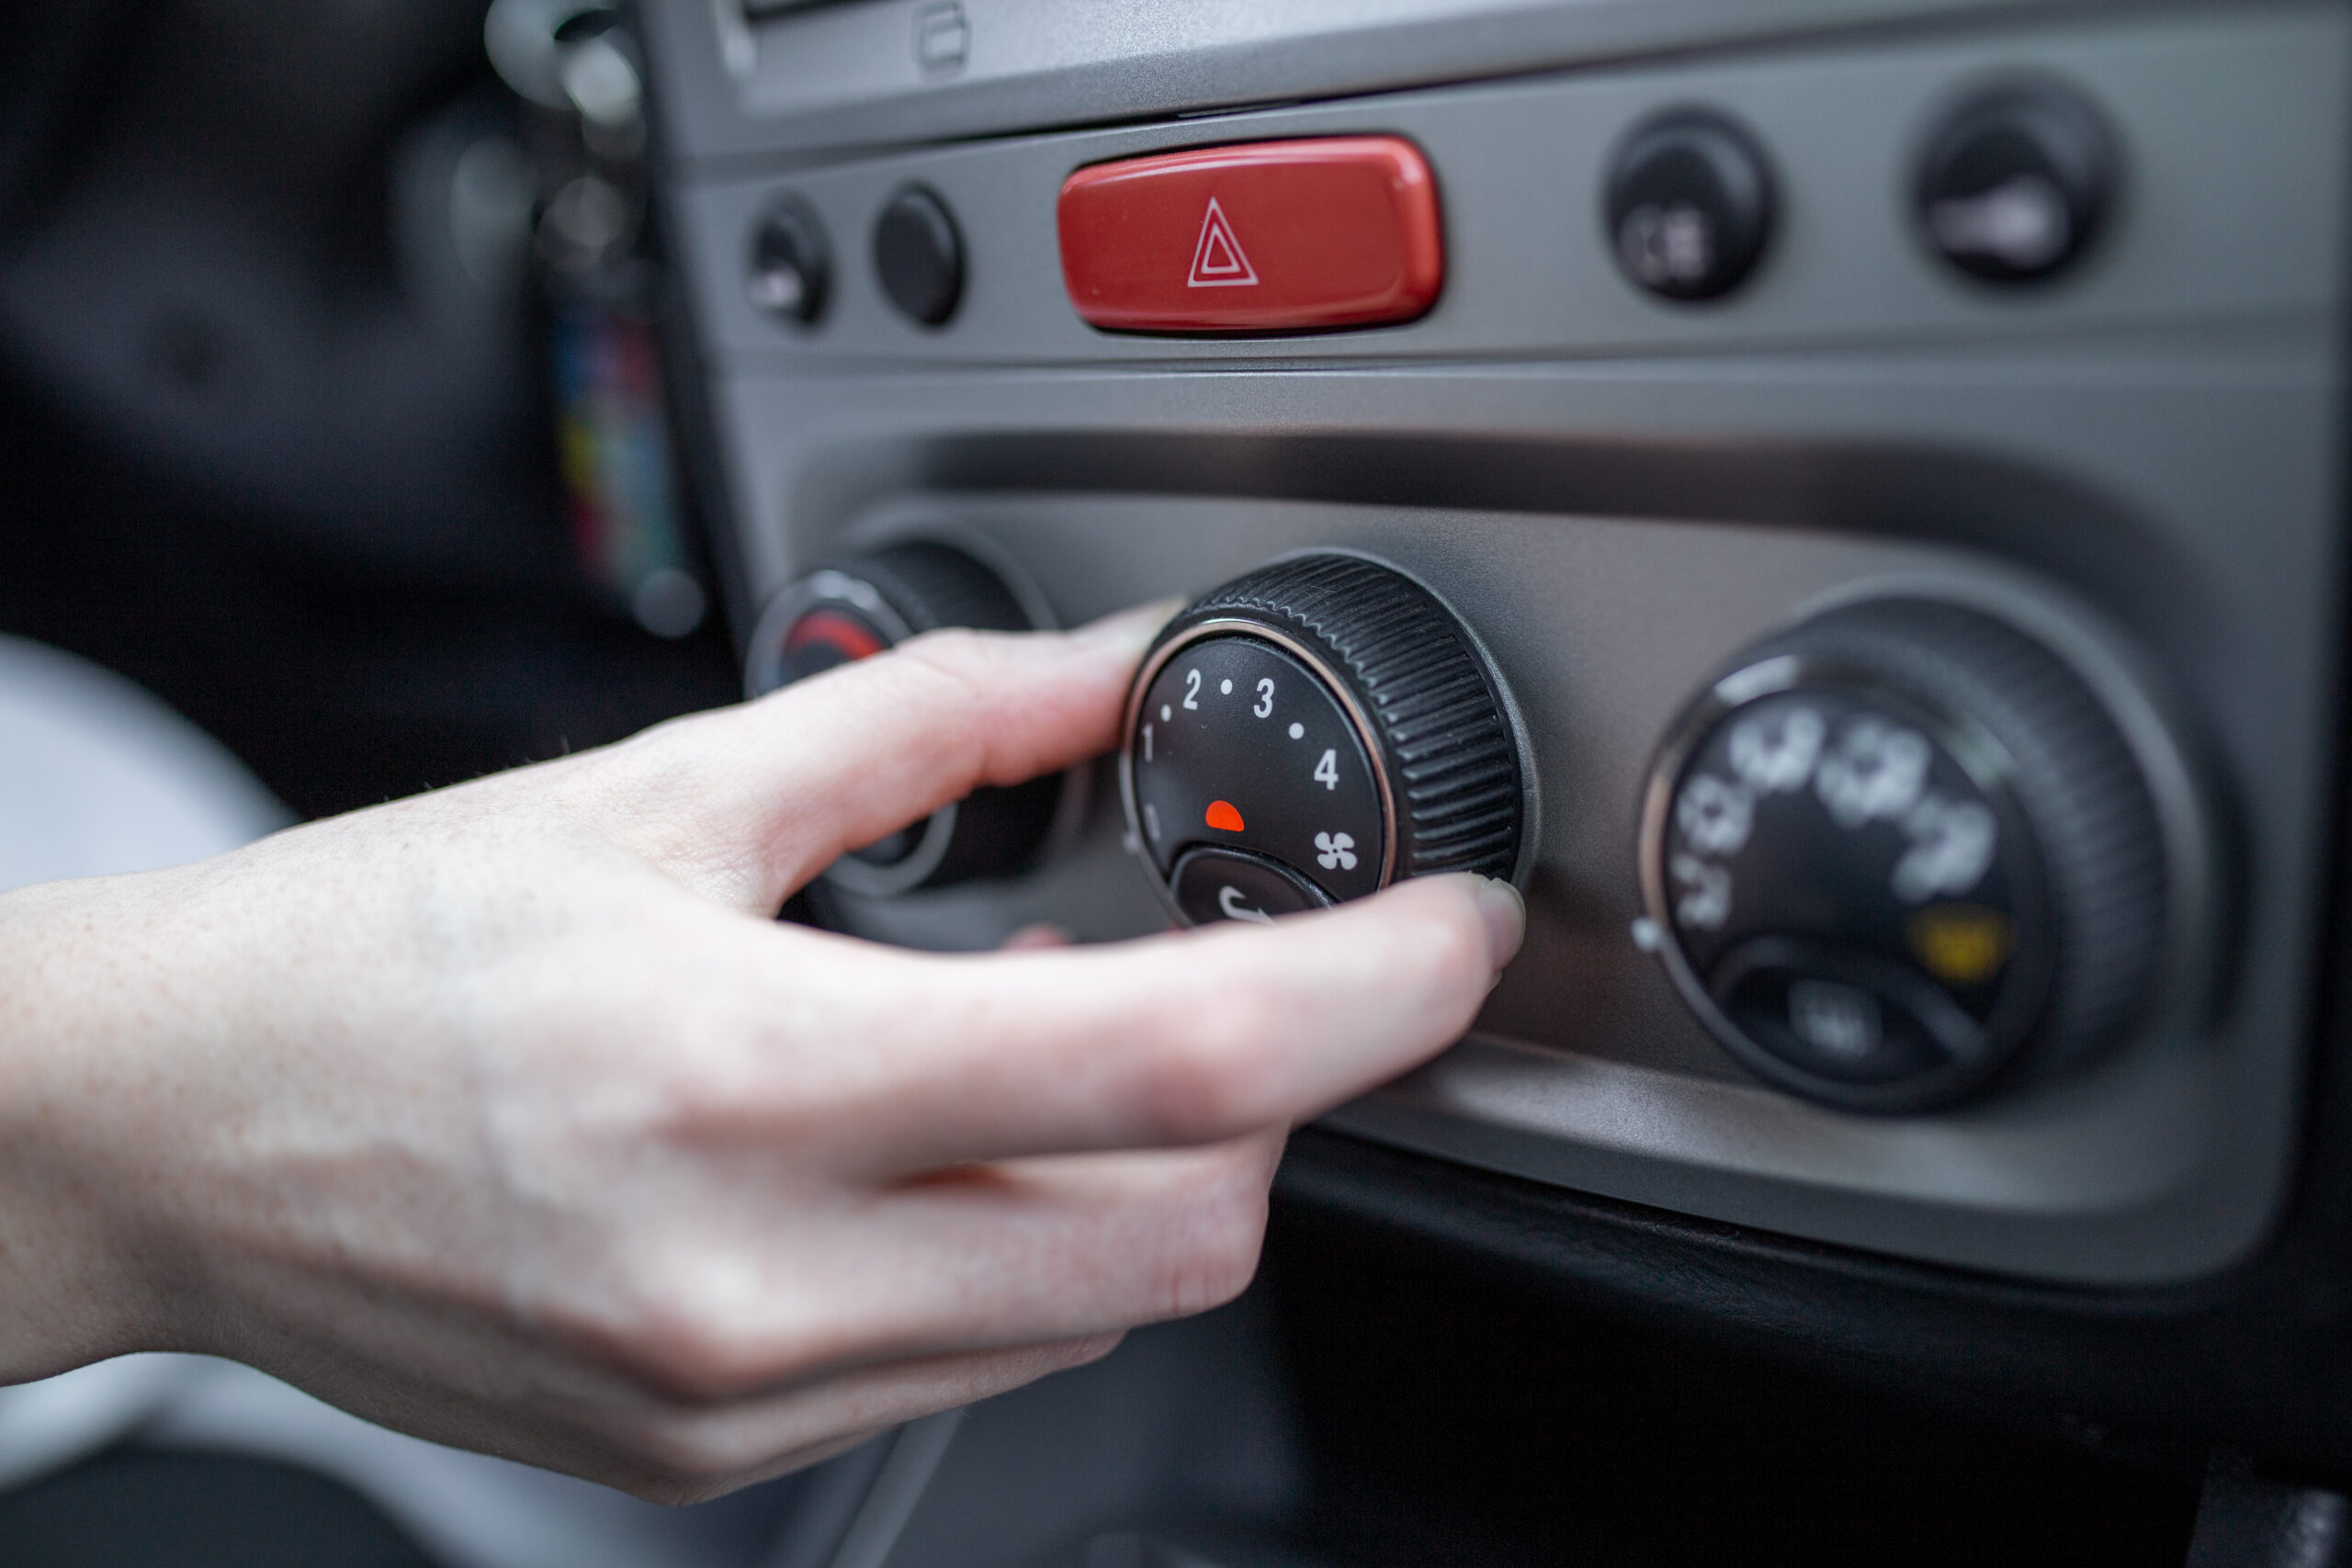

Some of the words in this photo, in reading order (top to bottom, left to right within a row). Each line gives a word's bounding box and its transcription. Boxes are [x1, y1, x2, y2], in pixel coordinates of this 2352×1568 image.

[1183, 669, 1202, 710] 2
[1253, 678, 1275, 718] 3
[1142, 723, 1154, 762] 1
[1314, 749, 1340, 790] 4
